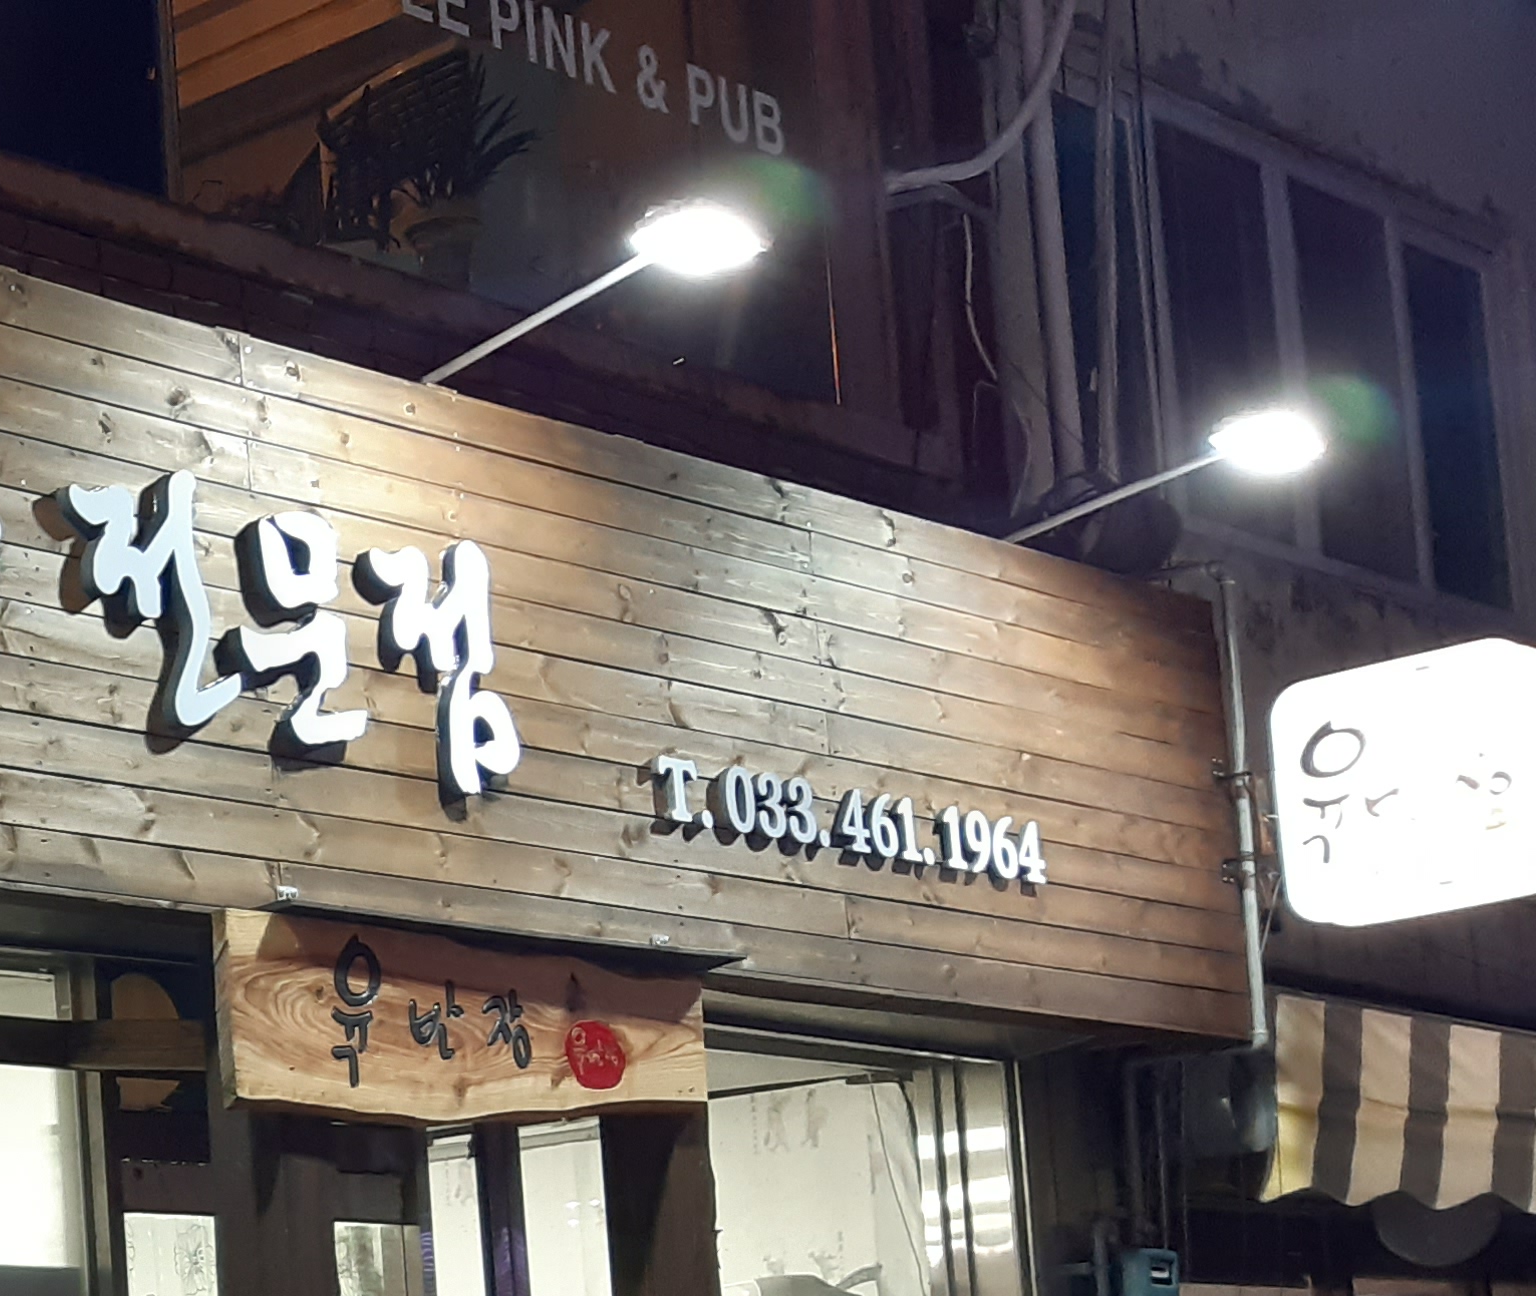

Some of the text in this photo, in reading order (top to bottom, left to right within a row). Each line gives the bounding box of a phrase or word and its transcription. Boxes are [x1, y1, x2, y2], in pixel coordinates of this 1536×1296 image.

[491, 0, 617, 94] PINK
[637, 43, 671, 114] &
[685, 62, 783, 156] PUB
[69, 469, 520, 798] 전문점
[728, 765, 830, 848] 033.
[841, 789, 934, 866] 461.
[938, 805, 1048, 884] 1964
[331, 932, 532, 1088] 육반장
